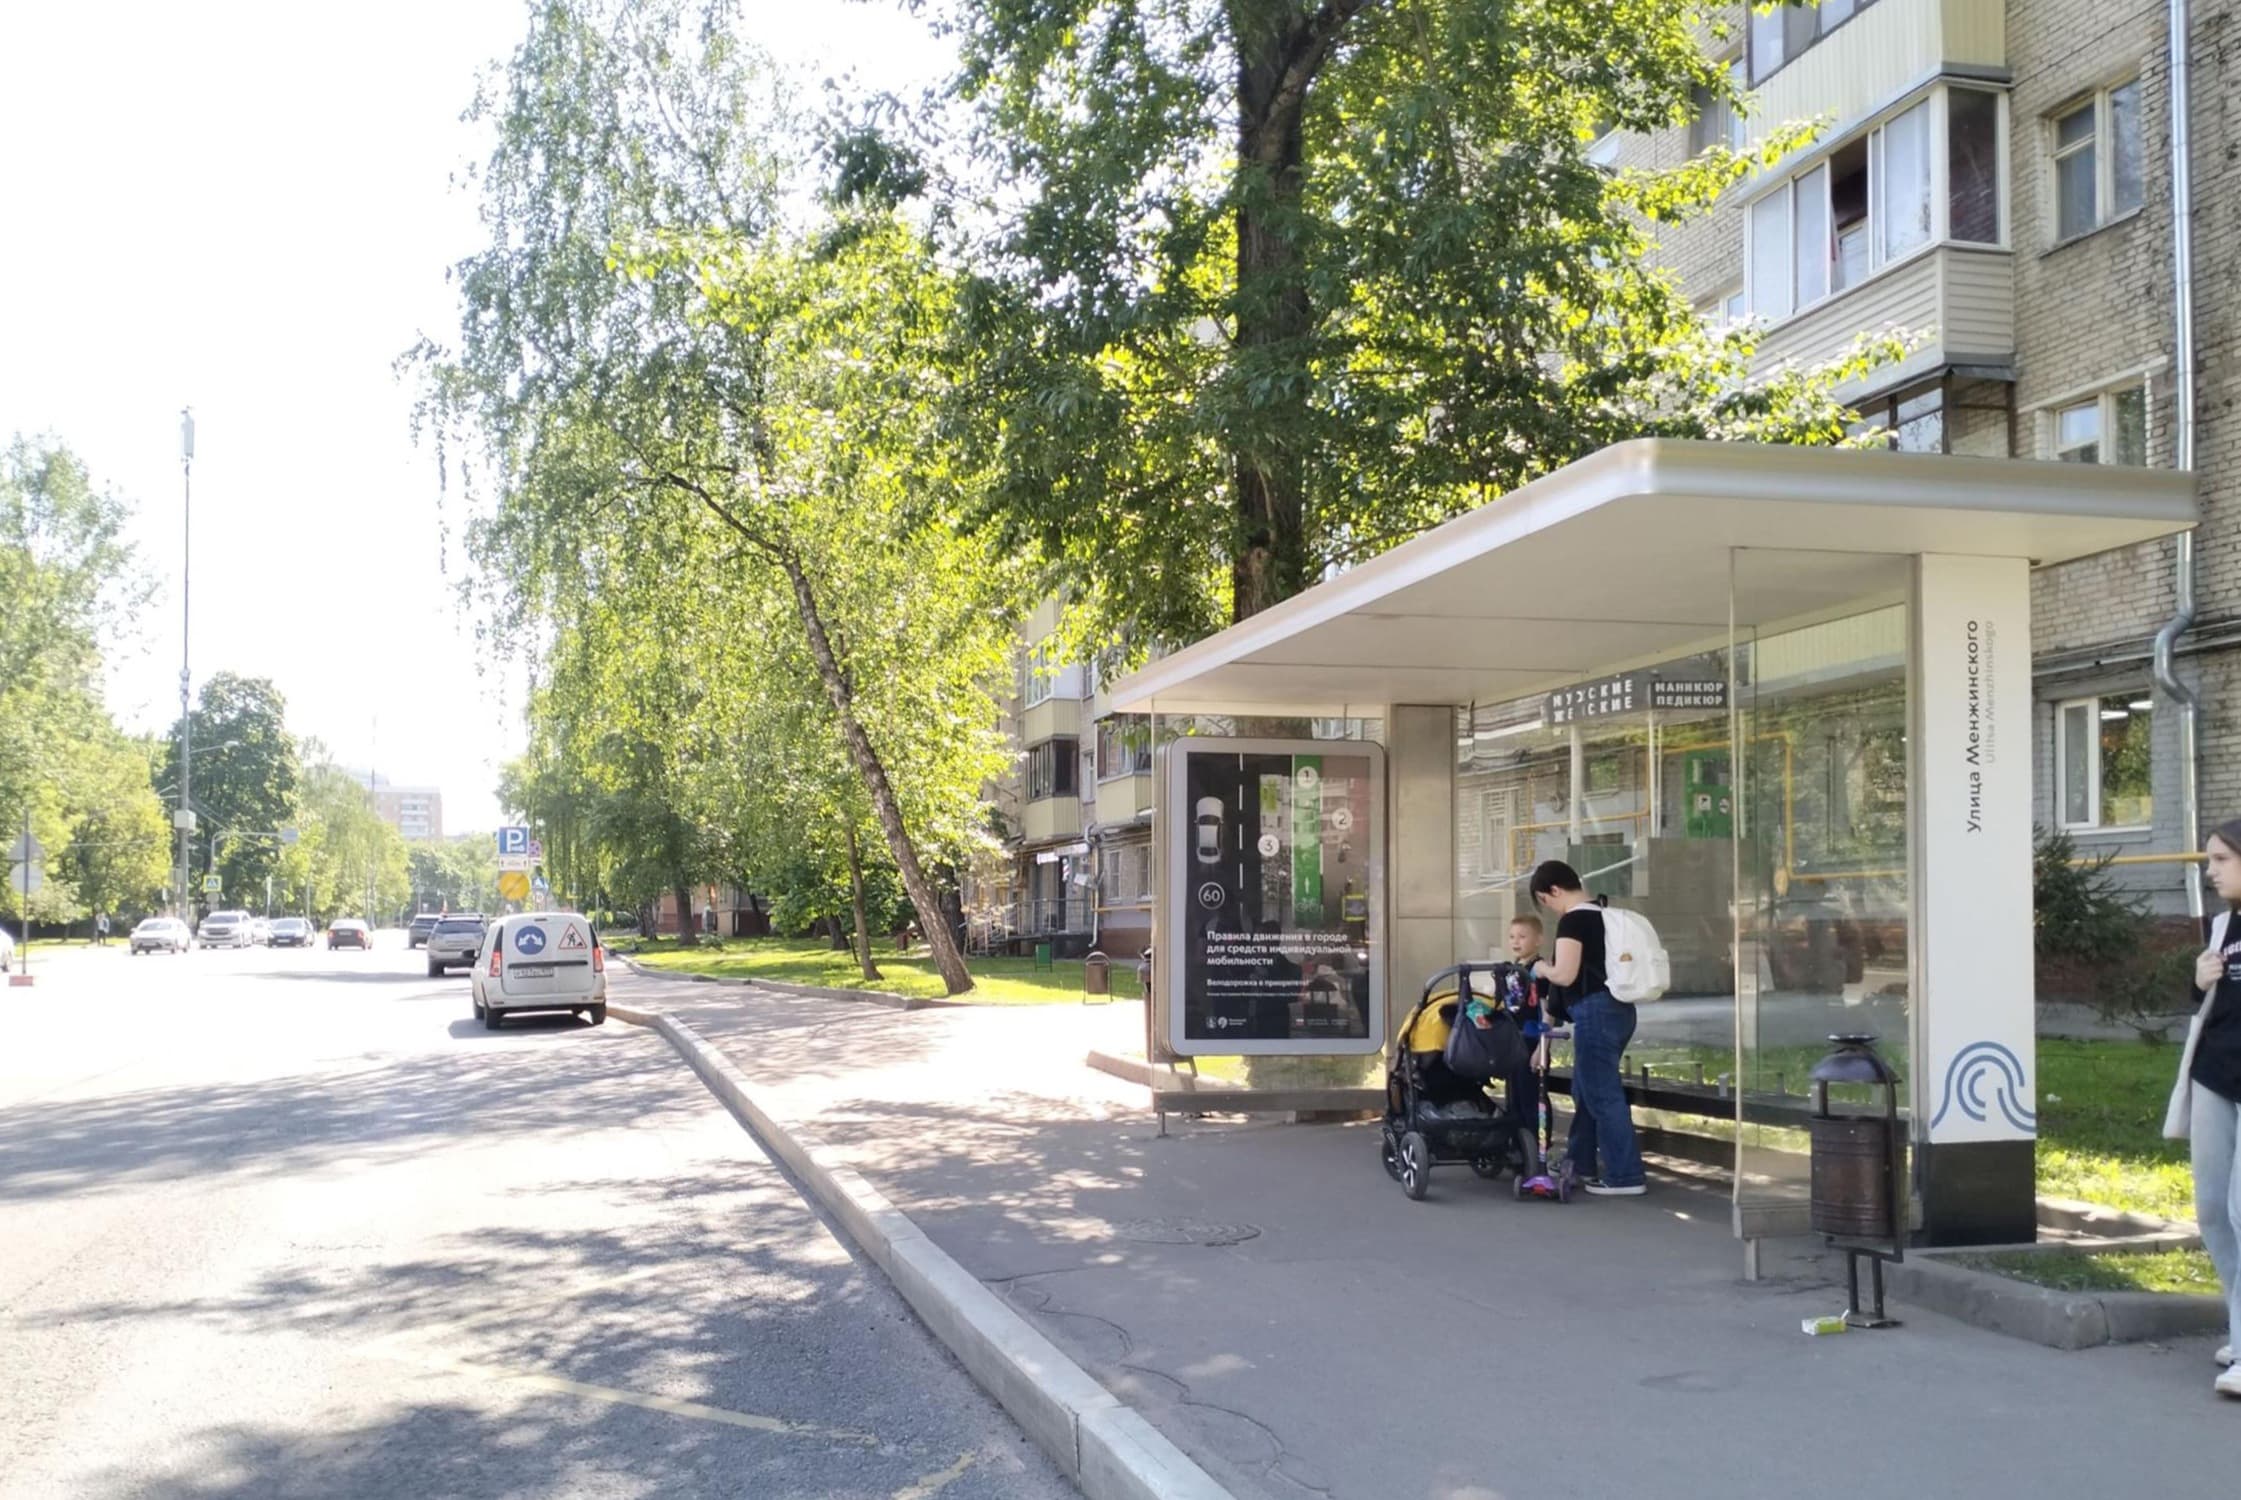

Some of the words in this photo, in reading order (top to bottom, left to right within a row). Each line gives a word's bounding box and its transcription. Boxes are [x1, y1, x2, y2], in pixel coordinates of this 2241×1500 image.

[1984, 620, 1996, 721] Menzhinskogo
[1655, 682, 1724, 693] МАНИКЮР
[1966, 620, 1980, 766] Менжинского
[1656, 695, 1723, 707] ПЕДИКЮР
[1553, 696, 1633, 723] ЖЕСКИЕ
[1985, 724, 1995, 764] Ulitsa
[1967, 771, 1982, 833] Улица
[1338, 813, 1347, 826] 2
[1264, 839, 1273, 852] 3
[1203, 890, 1221, 903] 60
[1207, 931, 1250, 943] Правила
[1253, 932, 1302, 943] движения
[1313, 932, 1348, 943] городе
[1207, 945, 1225, 954] для
[1227, 945, 1267, 955] средств
[1269, 944, 1351, 956] индивидуальной
[1207, 955, 1273, 966] мобильности
